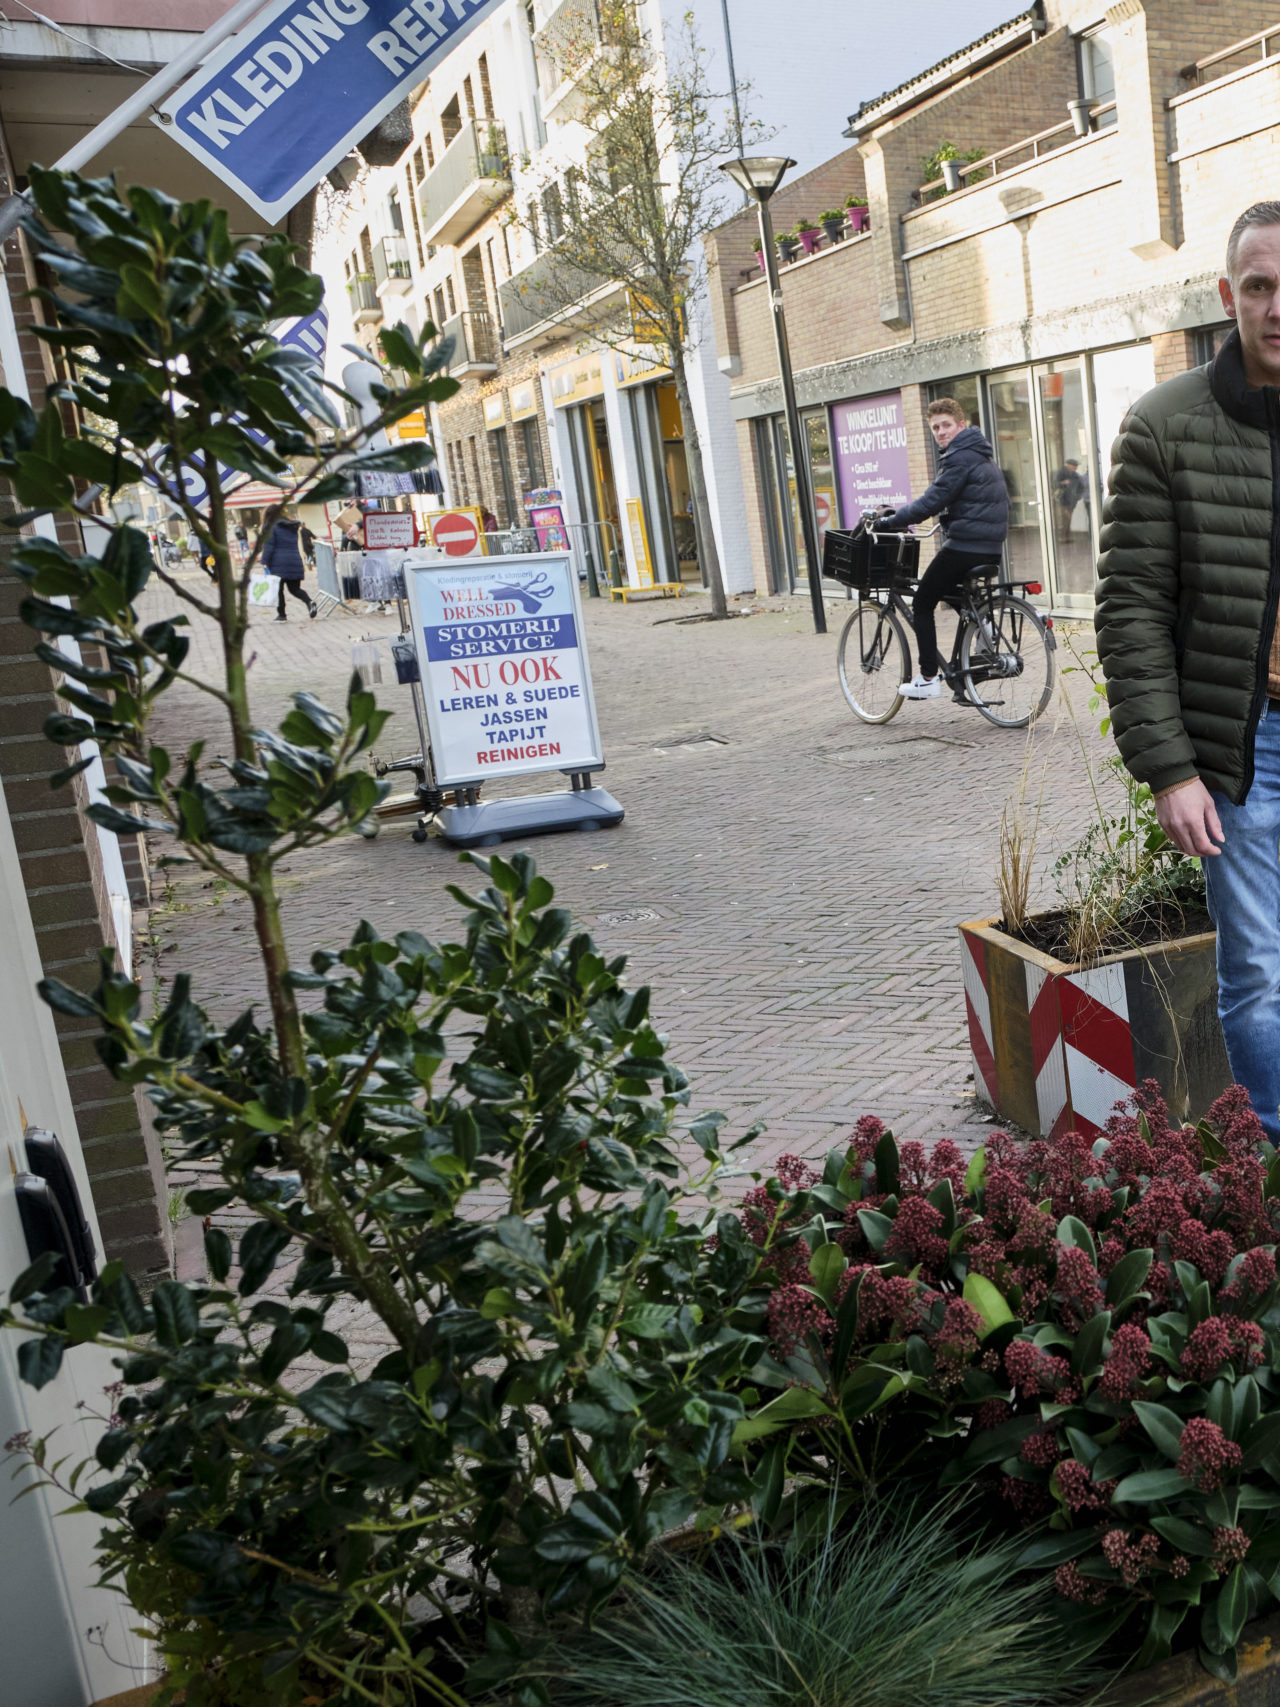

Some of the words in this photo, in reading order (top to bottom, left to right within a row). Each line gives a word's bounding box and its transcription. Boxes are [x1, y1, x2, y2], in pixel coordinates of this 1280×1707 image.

[186, 0, 370, 150] KLEDING
[846, 404, 897, 431] WINKELUNIT
[838, 436, 849, 454] TE
[440, 587, 489, 604] WELL
[443, 602, 517, 621] DRESSED
[438, 618, 561, 642] STOMERIJ
[450, 634, 556, 657] SERVICE
[450, 662, 491, 691] NU
[499, 656, 562, 686] OOK
[440, 694, 499, 712] LEREN
[505, 692, 518, 705] &
[523, 684, 581, 703] SUEDE
[480, 707, 548, 726] JASSEN
[486, 726, 546, 744] TAPIJT
[477, 742, 561, 764] REINIGEN
